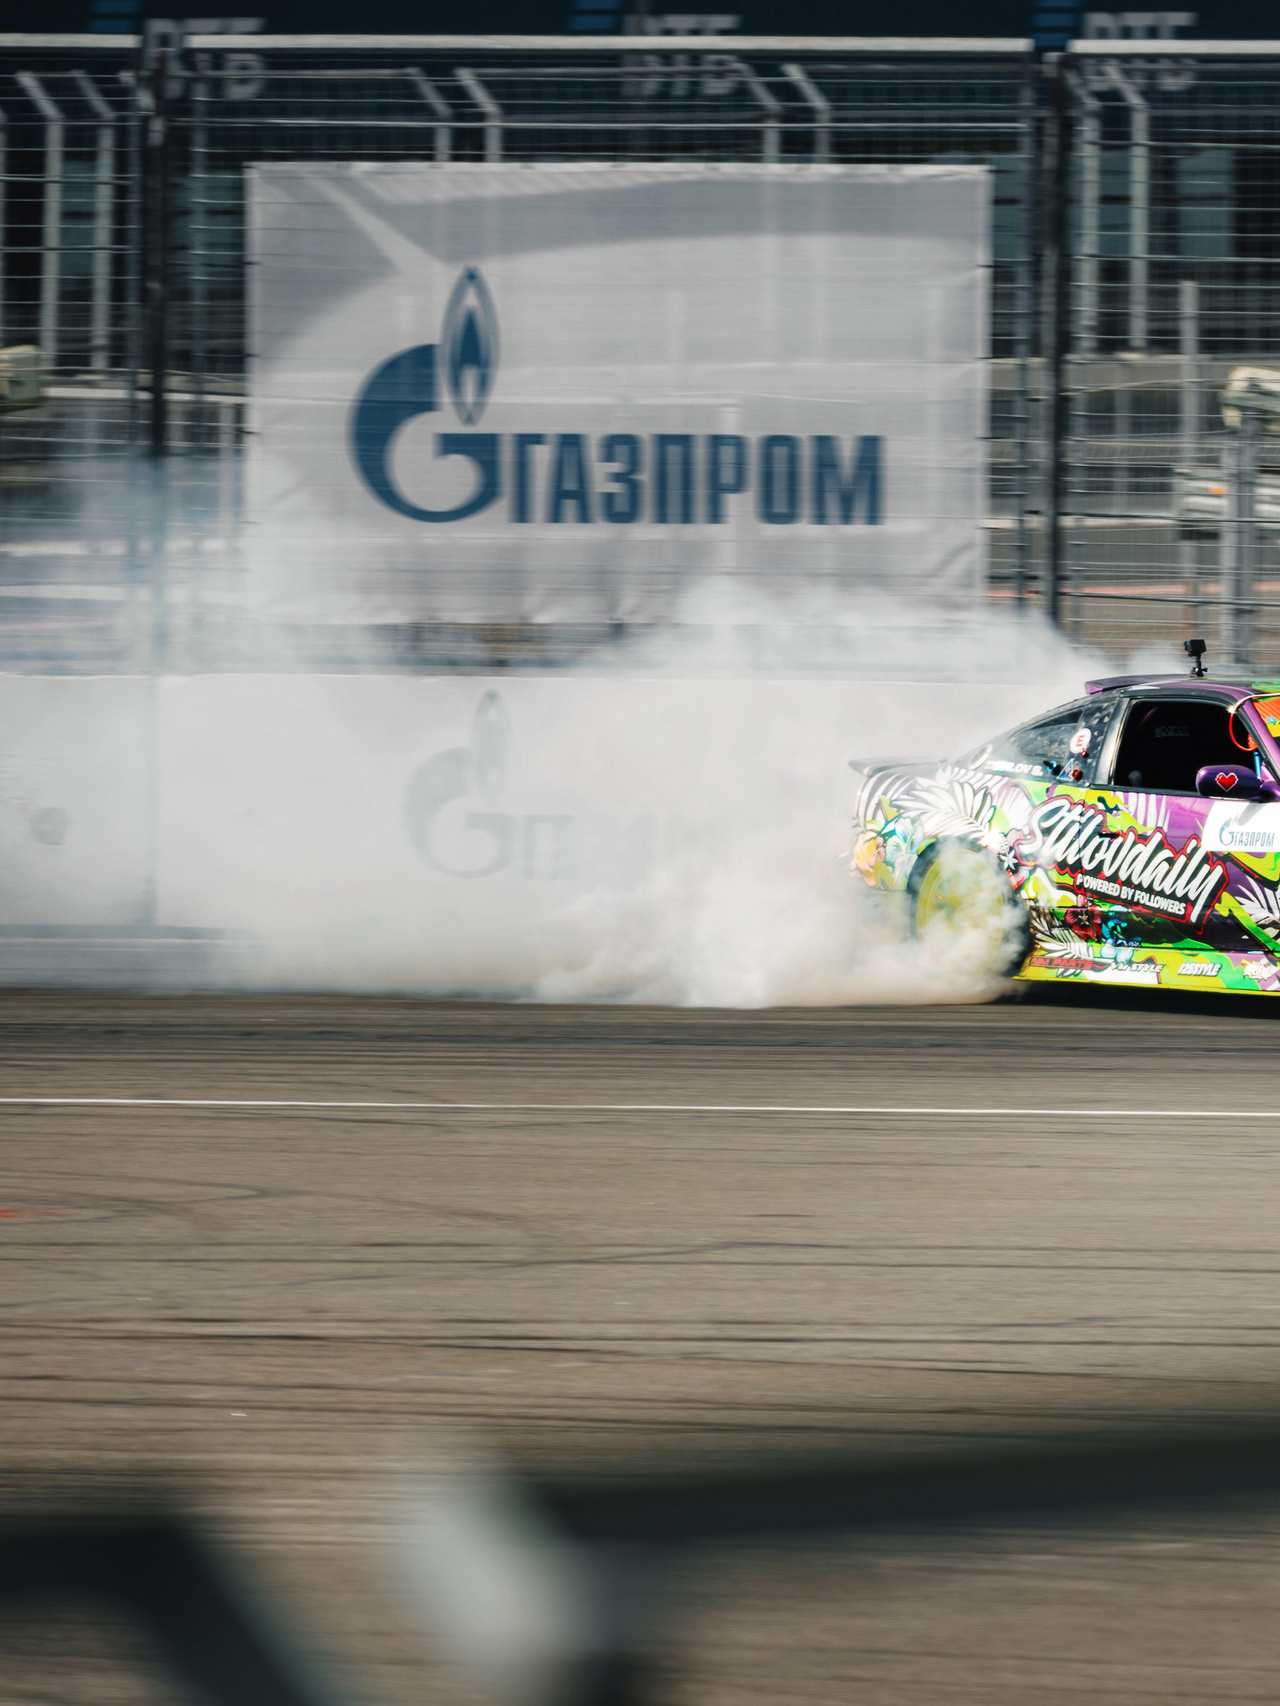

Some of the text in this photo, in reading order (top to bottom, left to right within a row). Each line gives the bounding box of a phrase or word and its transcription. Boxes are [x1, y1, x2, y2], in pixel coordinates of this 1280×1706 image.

[506, 433, 887, 526] ГАЗПРОМ
[1234, 831, 1276, 848] ГАЗПРОМ
[1019, 798, 1224, 924] Stilovdaily
[1076, 873, 1187, 915] POWERED BY FOLLOWERS
[1052, 958, 1093, 969] PARTS
